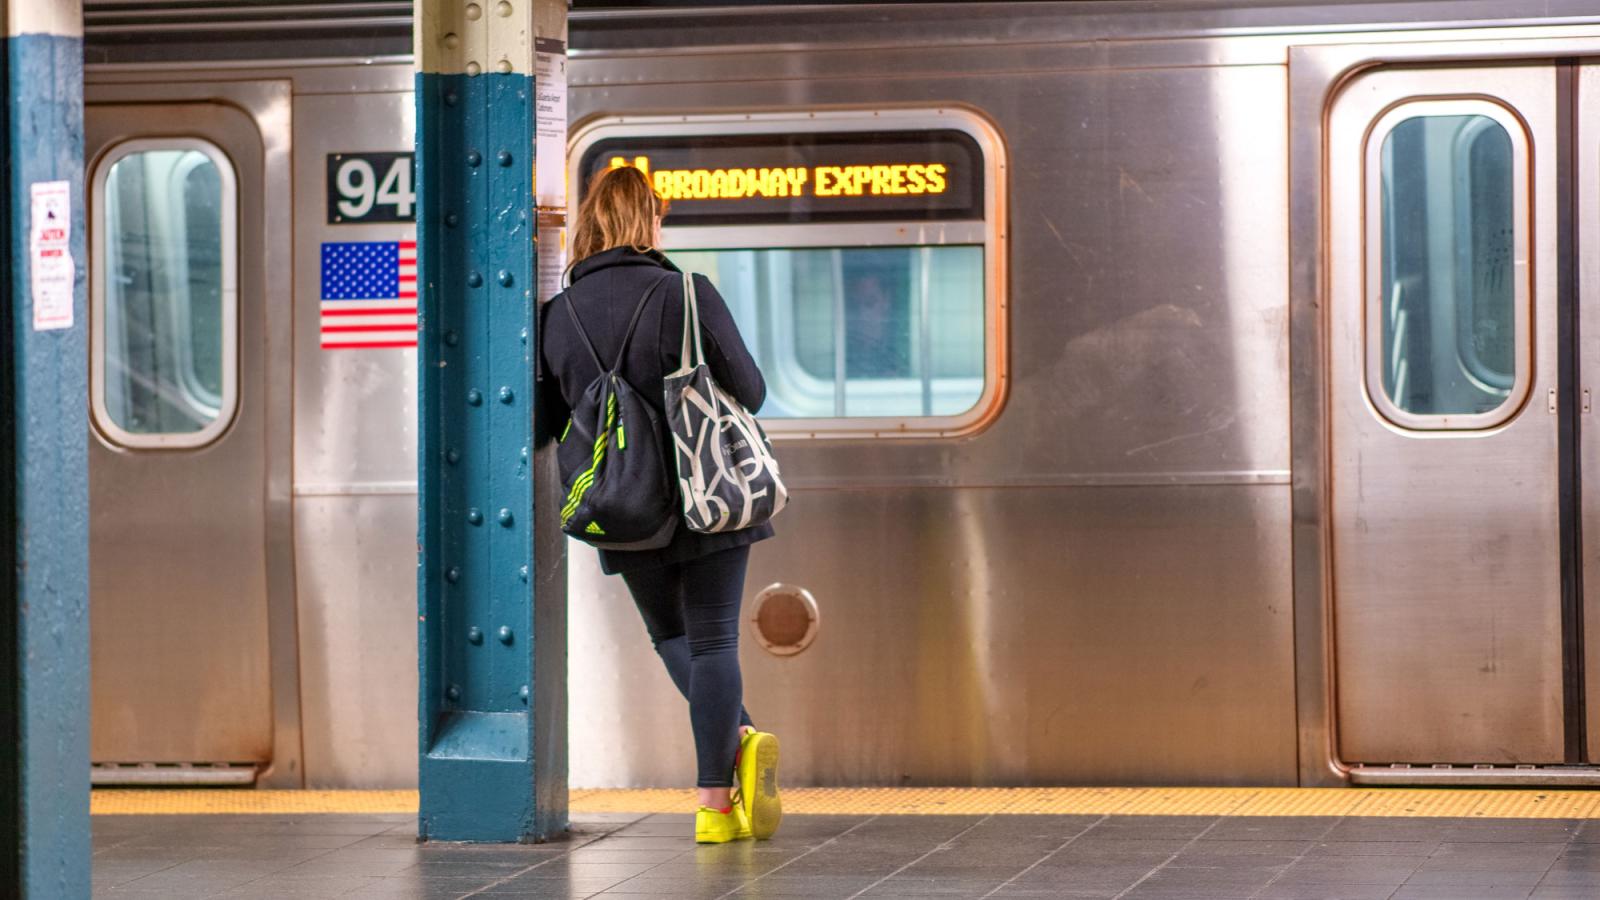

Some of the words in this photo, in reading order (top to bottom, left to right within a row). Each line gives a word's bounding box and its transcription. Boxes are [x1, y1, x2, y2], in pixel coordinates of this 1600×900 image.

[336, 157, 415, 218] 94
[653, 167, 807, 199] BROADWAY
[814, 163, 946, 196] EXPRESS
